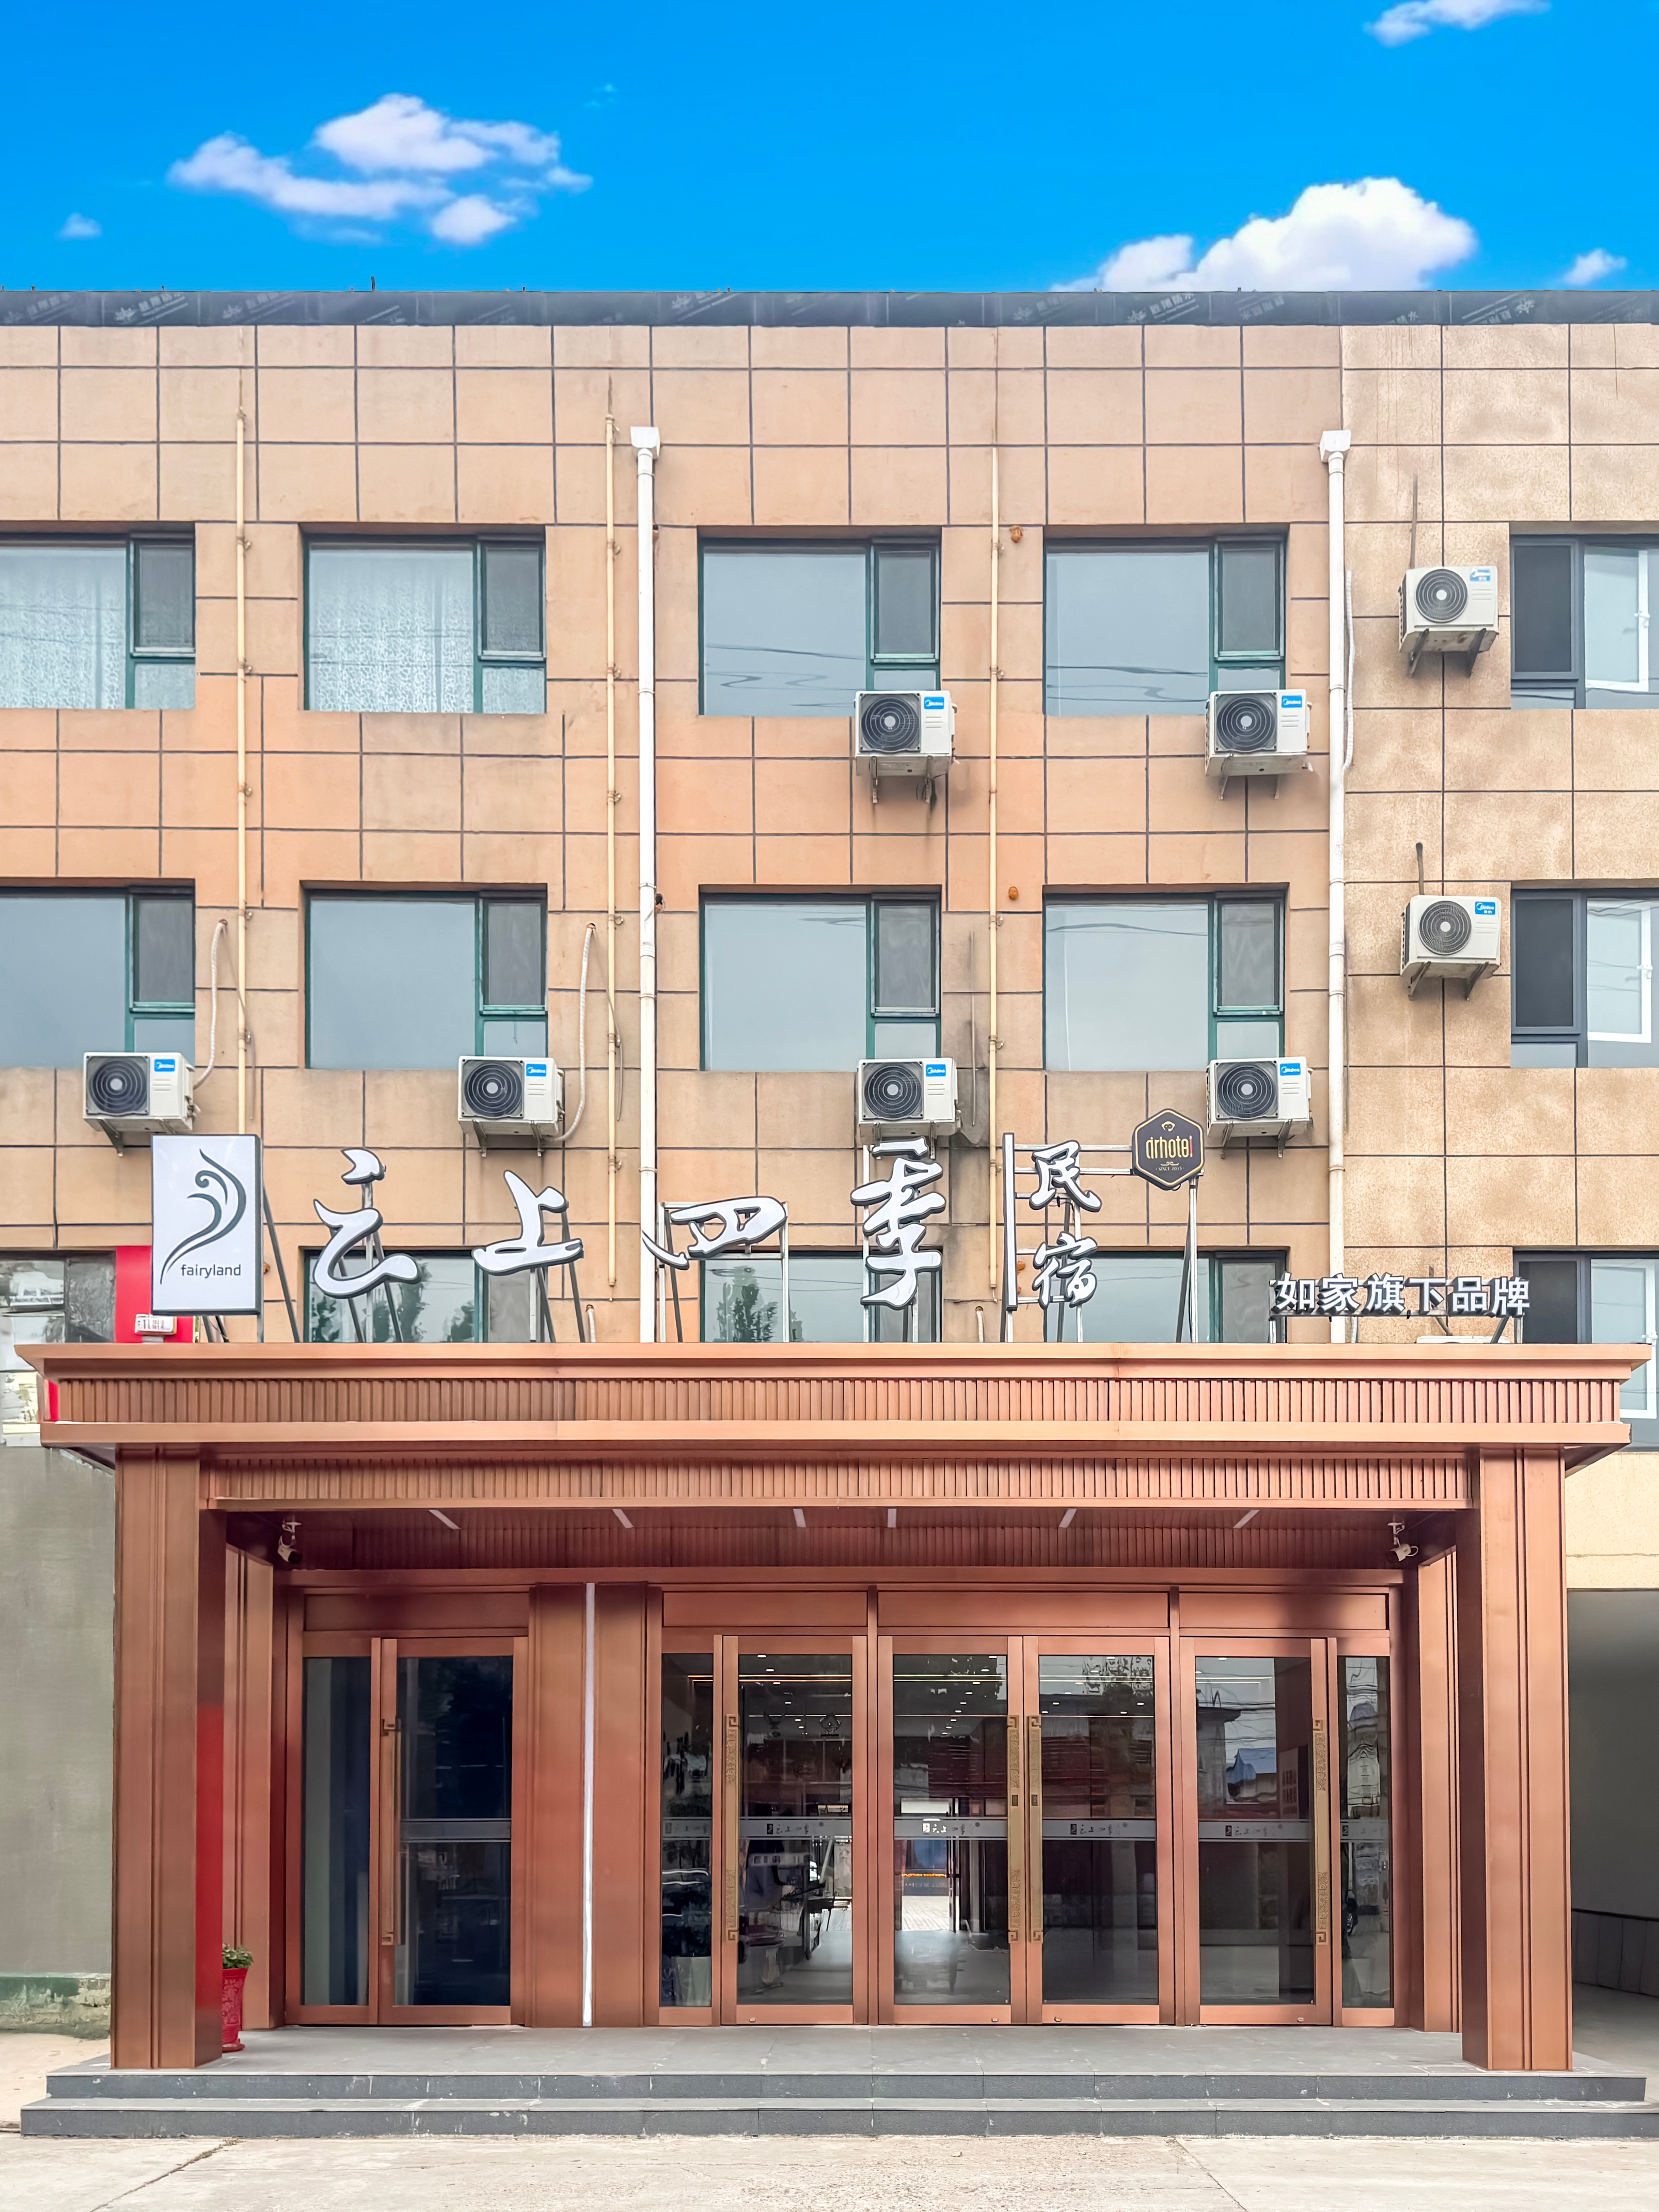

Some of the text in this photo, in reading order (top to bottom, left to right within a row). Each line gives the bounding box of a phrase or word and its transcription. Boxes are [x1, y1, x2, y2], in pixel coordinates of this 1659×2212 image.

[1030, 1139, 1102, 1309] 民宿
[181, 1264, 241, 1278] fairyland
[1271, 1272, 1530, 1317] 如家旗下品牌
